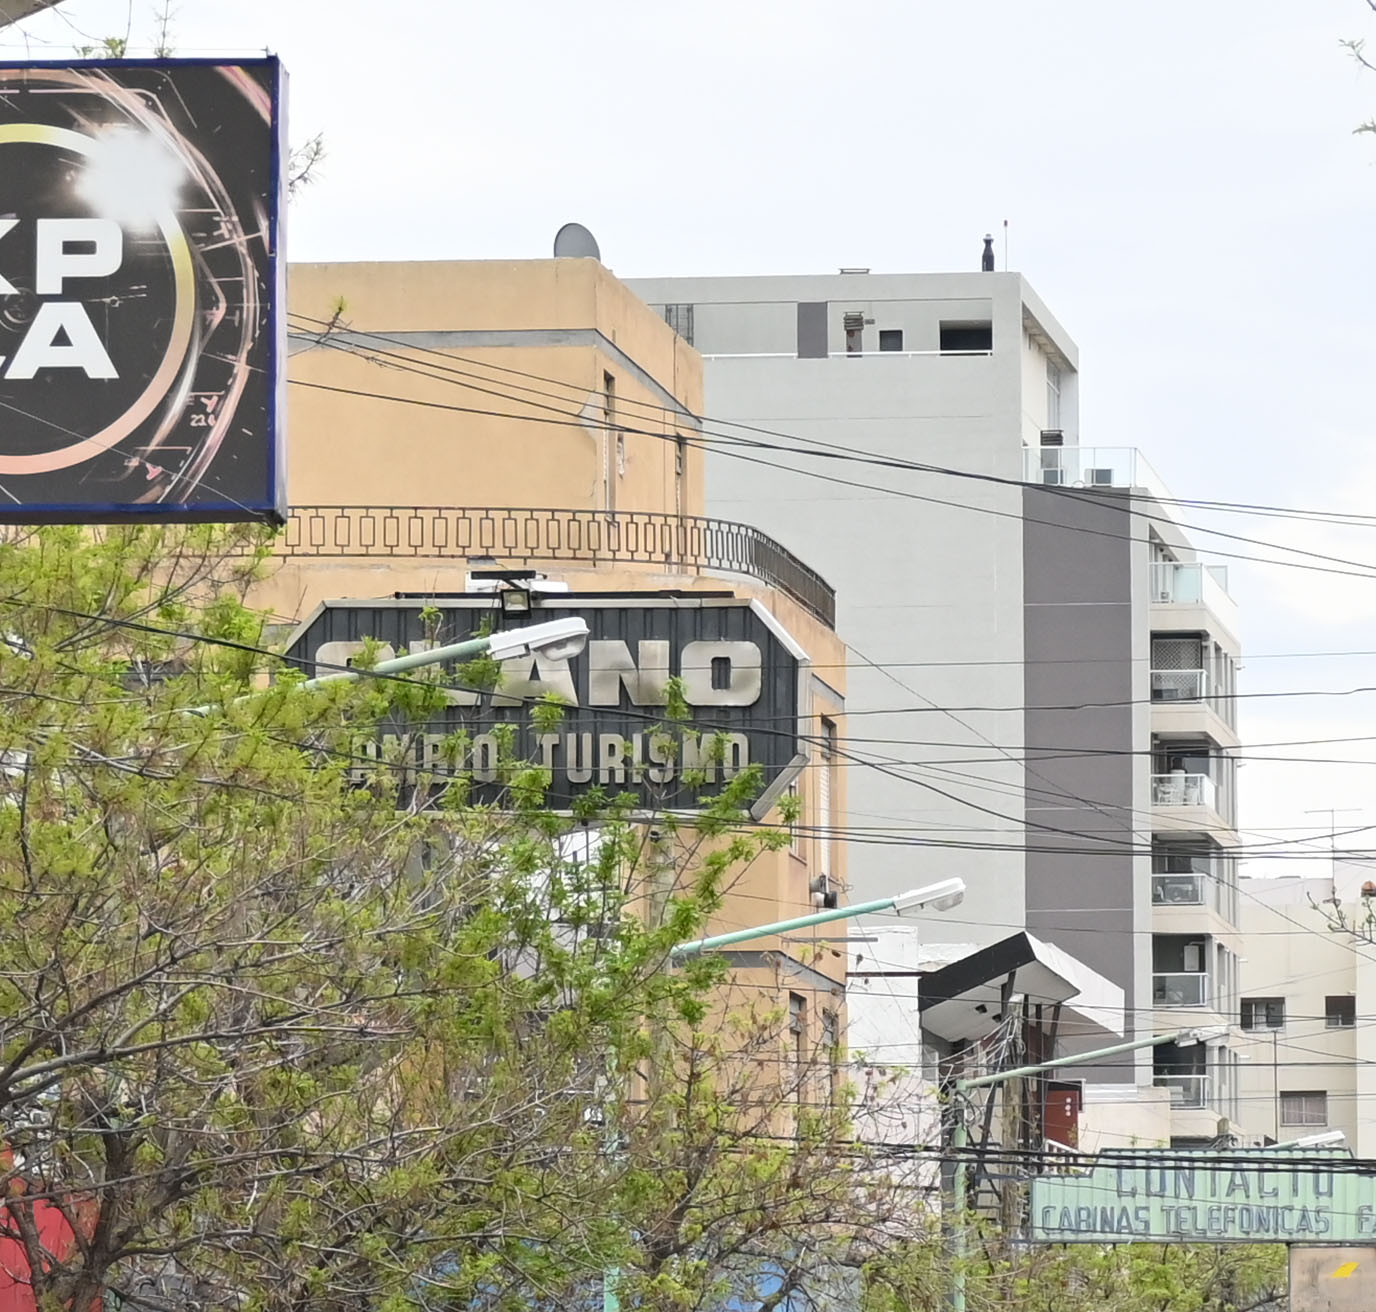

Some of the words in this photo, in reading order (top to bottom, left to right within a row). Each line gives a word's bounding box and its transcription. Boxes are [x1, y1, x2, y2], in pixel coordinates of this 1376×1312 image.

[536, 732, 748, 784] TURISMO
[1041, 1206, 1150, 1235] CABINAS
[1161, 1205, 1330, 1235] TELEFONICAS
